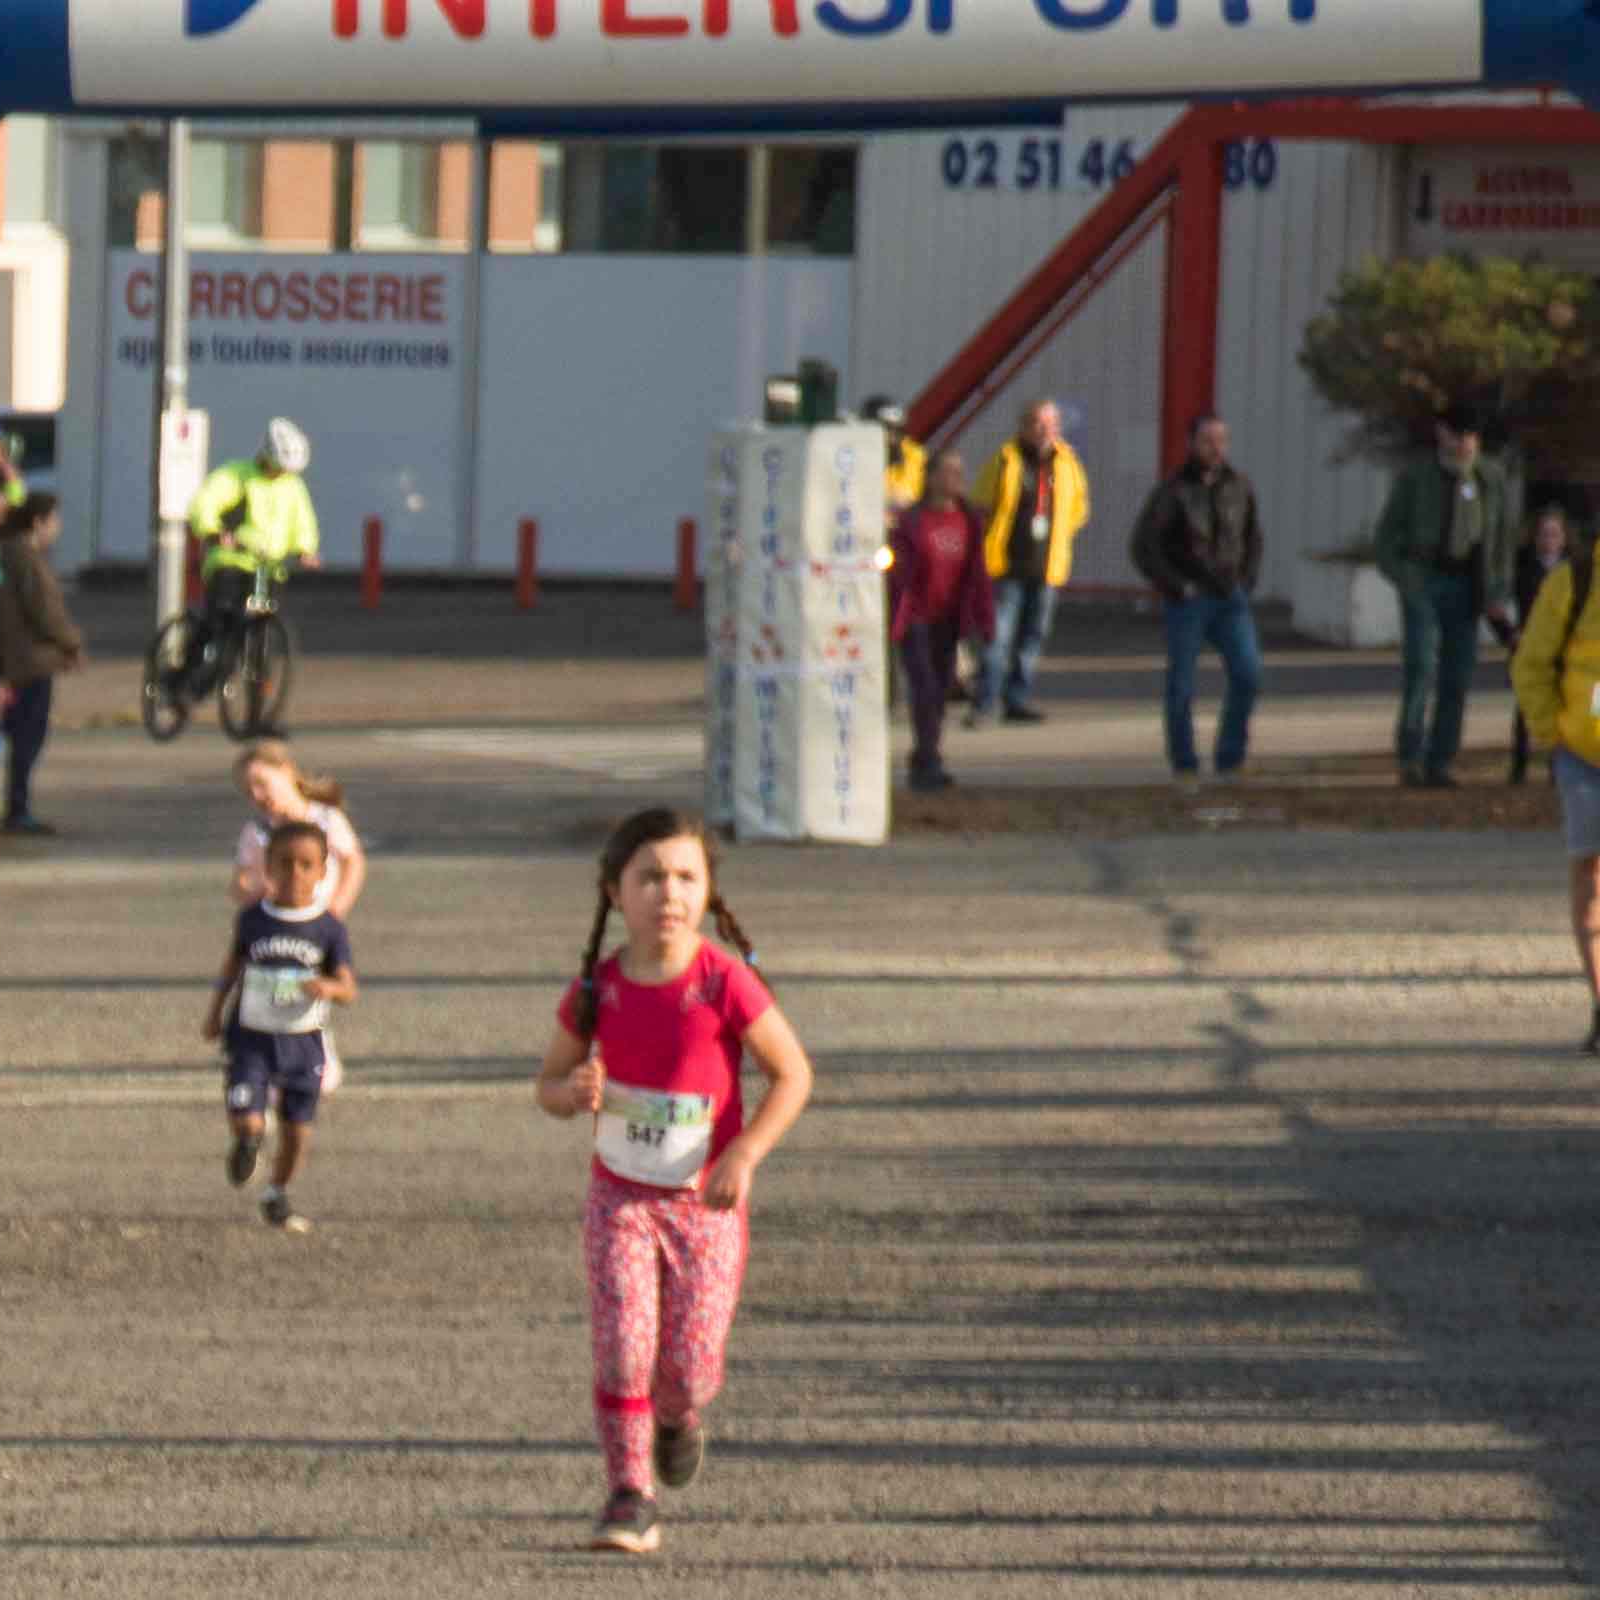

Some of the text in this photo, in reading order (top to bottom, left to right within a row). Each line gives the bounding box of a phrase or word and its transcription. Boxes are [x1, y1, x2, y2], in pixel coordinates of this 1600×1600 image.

[942, 138, 999, 188] 02
[1016, 138, 1061, 188] 51
[125, 272, 448, 322] CRROSSERIE
